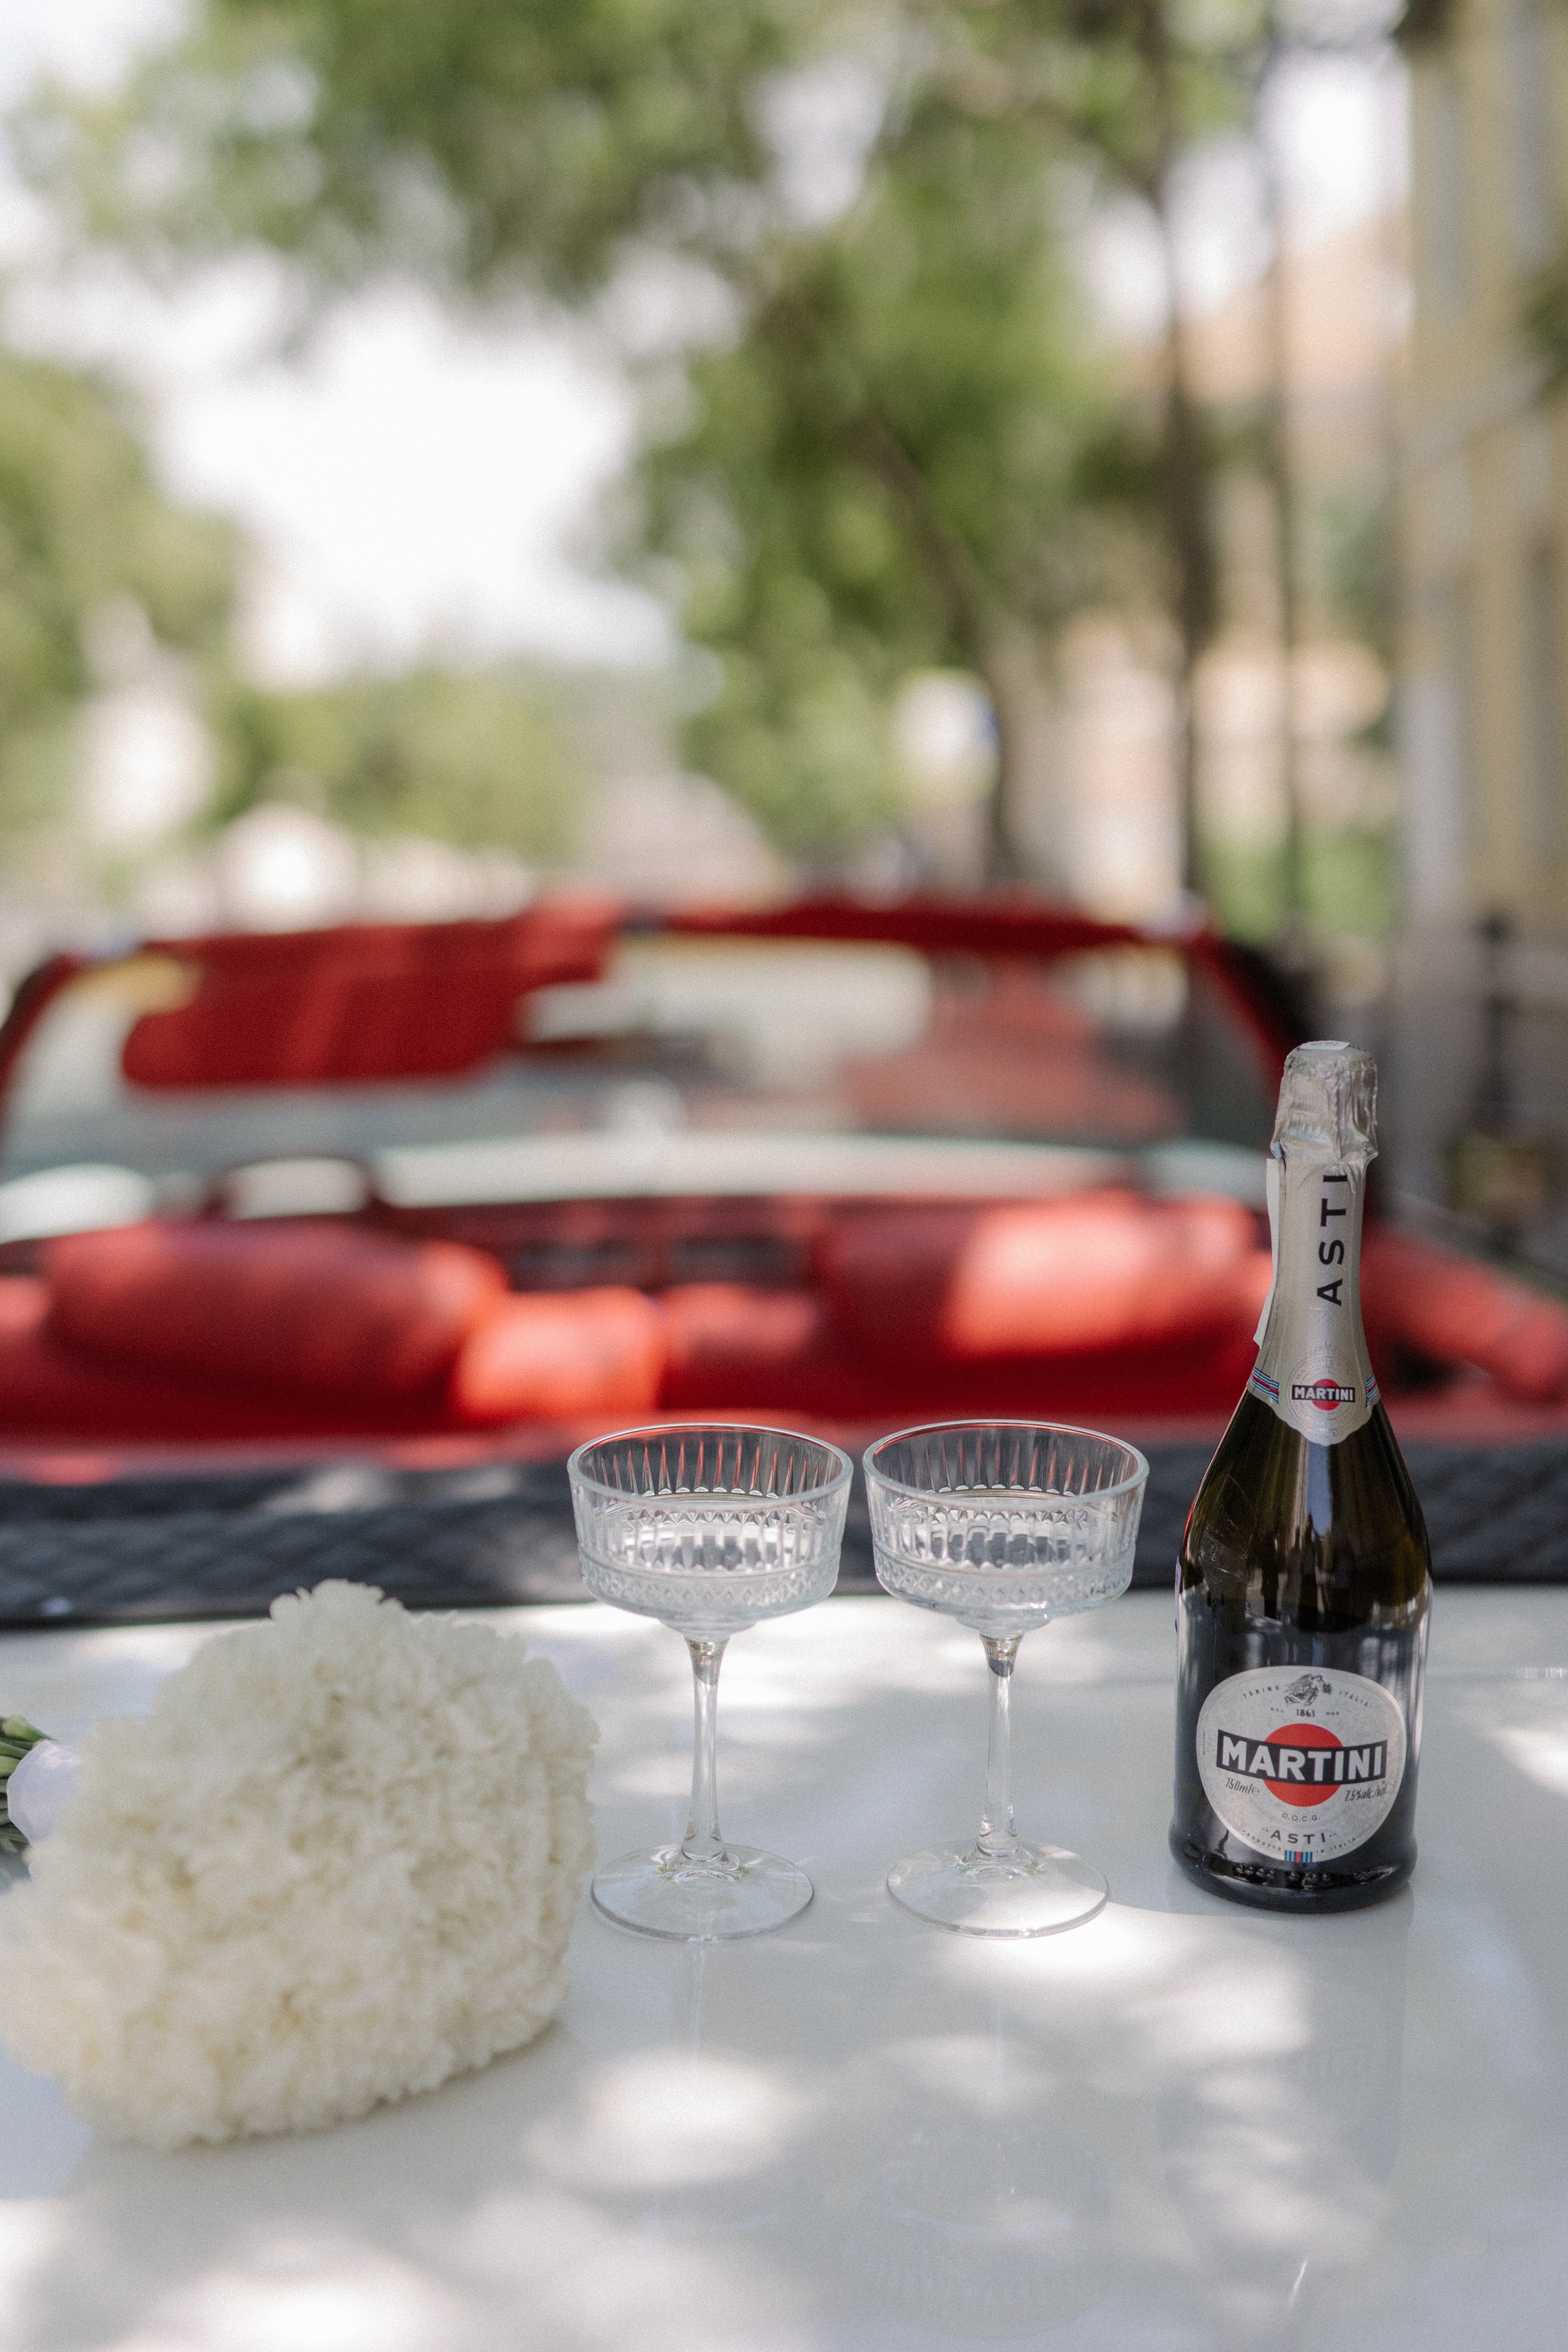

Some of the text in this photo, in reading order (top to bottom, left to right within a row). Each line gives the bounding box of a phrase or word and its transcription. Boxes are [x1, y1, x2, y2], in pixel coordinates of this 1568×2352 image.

[1317, 1175, 1348, 1306] ASTI
[1294, 1387, 1354, 1401] MARTINI
[1243, 1686, 1368, 1707] TORINO ITALIA
[1296, 1708, 1315, 1717] 1863
[1222, 1735, 1382, 1782] MARTINI
[1282, 1812, 1321, 1822] D.O.C.G.
[1270, 1830, 1325, 1844] ASTI
[1330, 1838, 1355, 1850] ITALIA
